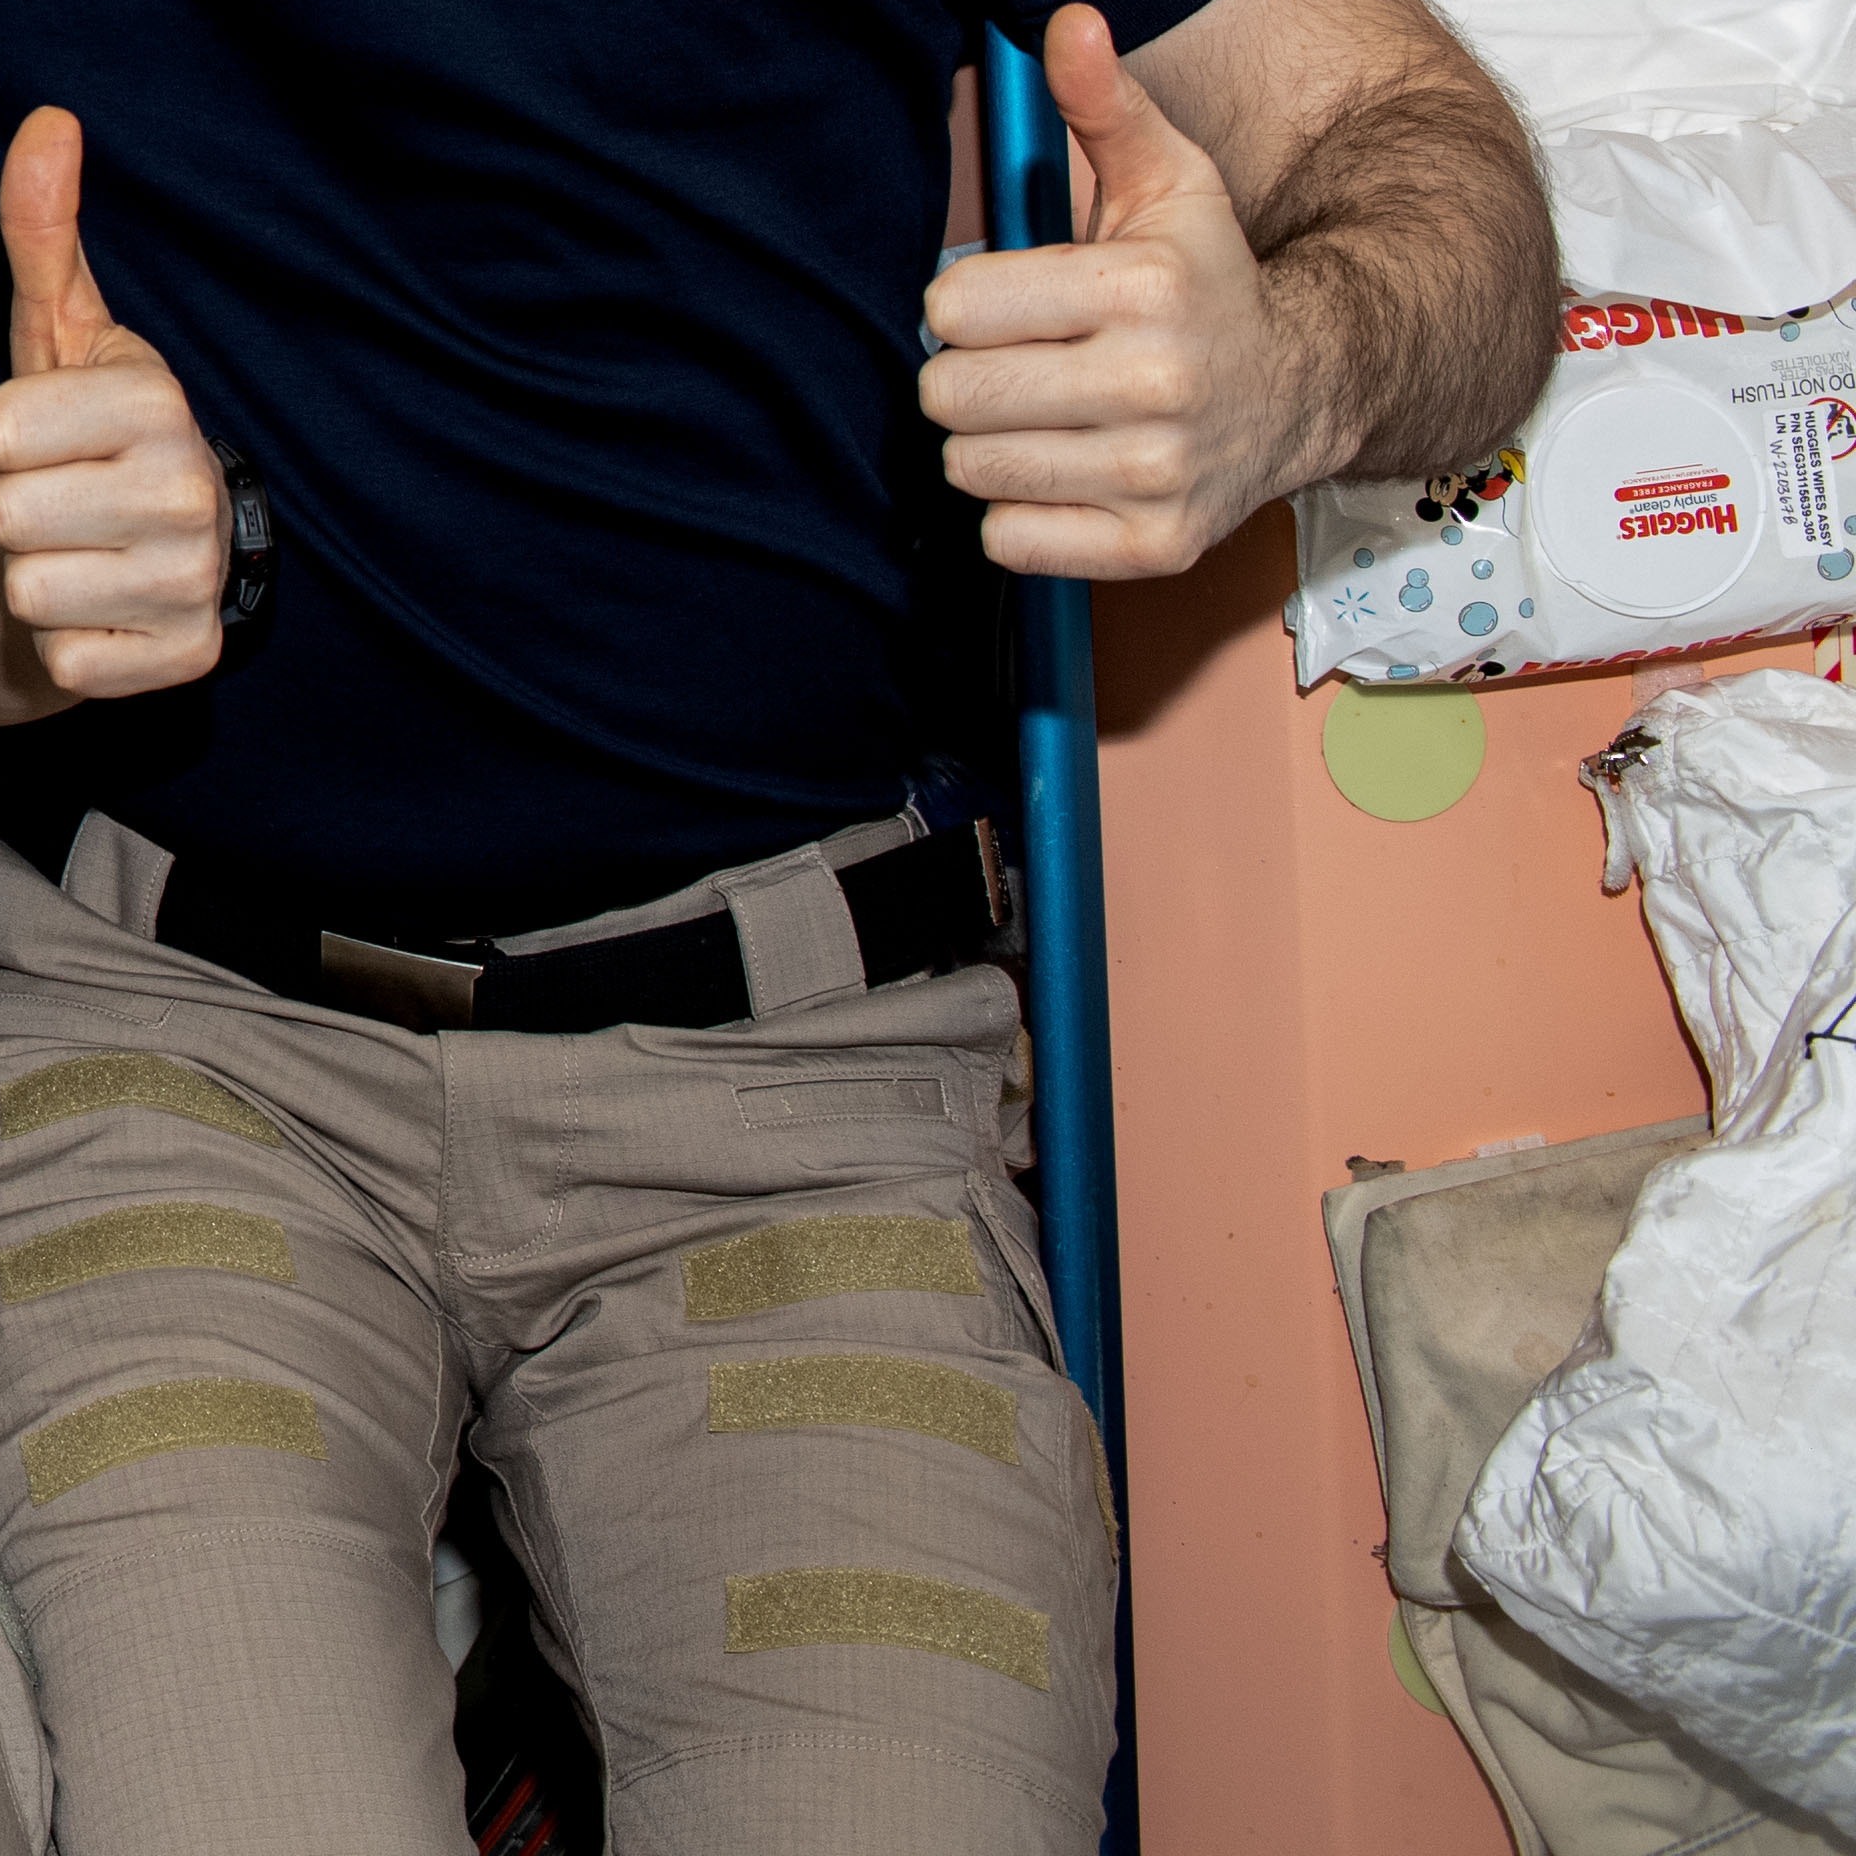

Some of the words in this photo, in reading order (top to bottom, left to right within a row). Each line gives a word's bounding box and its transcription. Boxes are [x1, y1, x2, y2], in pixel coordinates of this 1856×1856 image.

[1770, 354, 1825, 370] TOILETTES
[1826, 350, 1849, 362] AUX
[1779, 367, 1811, 380] JETER
[1812, 362, 1834, 374] PAS
[1789, 377, 1823, 395] NOT
[1828, 372, 1854, 389] DO
[1730, 382, 1785, 402] FLUSH
[1774, 414, 1786, 434] L/N
[1789, 412, 1802, 433] P/N
[1803, 410, 1820, 467] HUGGIES
[1631, 487, 1655, 496] FREE
[1657, 479, 1712, 493] FRAGRANCE
[1791, 435, 1816, 542] SEG33115639-305
[1811, 470, 1827, 511] WIPES
[1633, 499, 1670, 513] clean
[1673, 492, 1717, 509] simply
[1618, 503, 1737, 539] HUGGIES
[1817, 513, 1832, 548] ASSY
